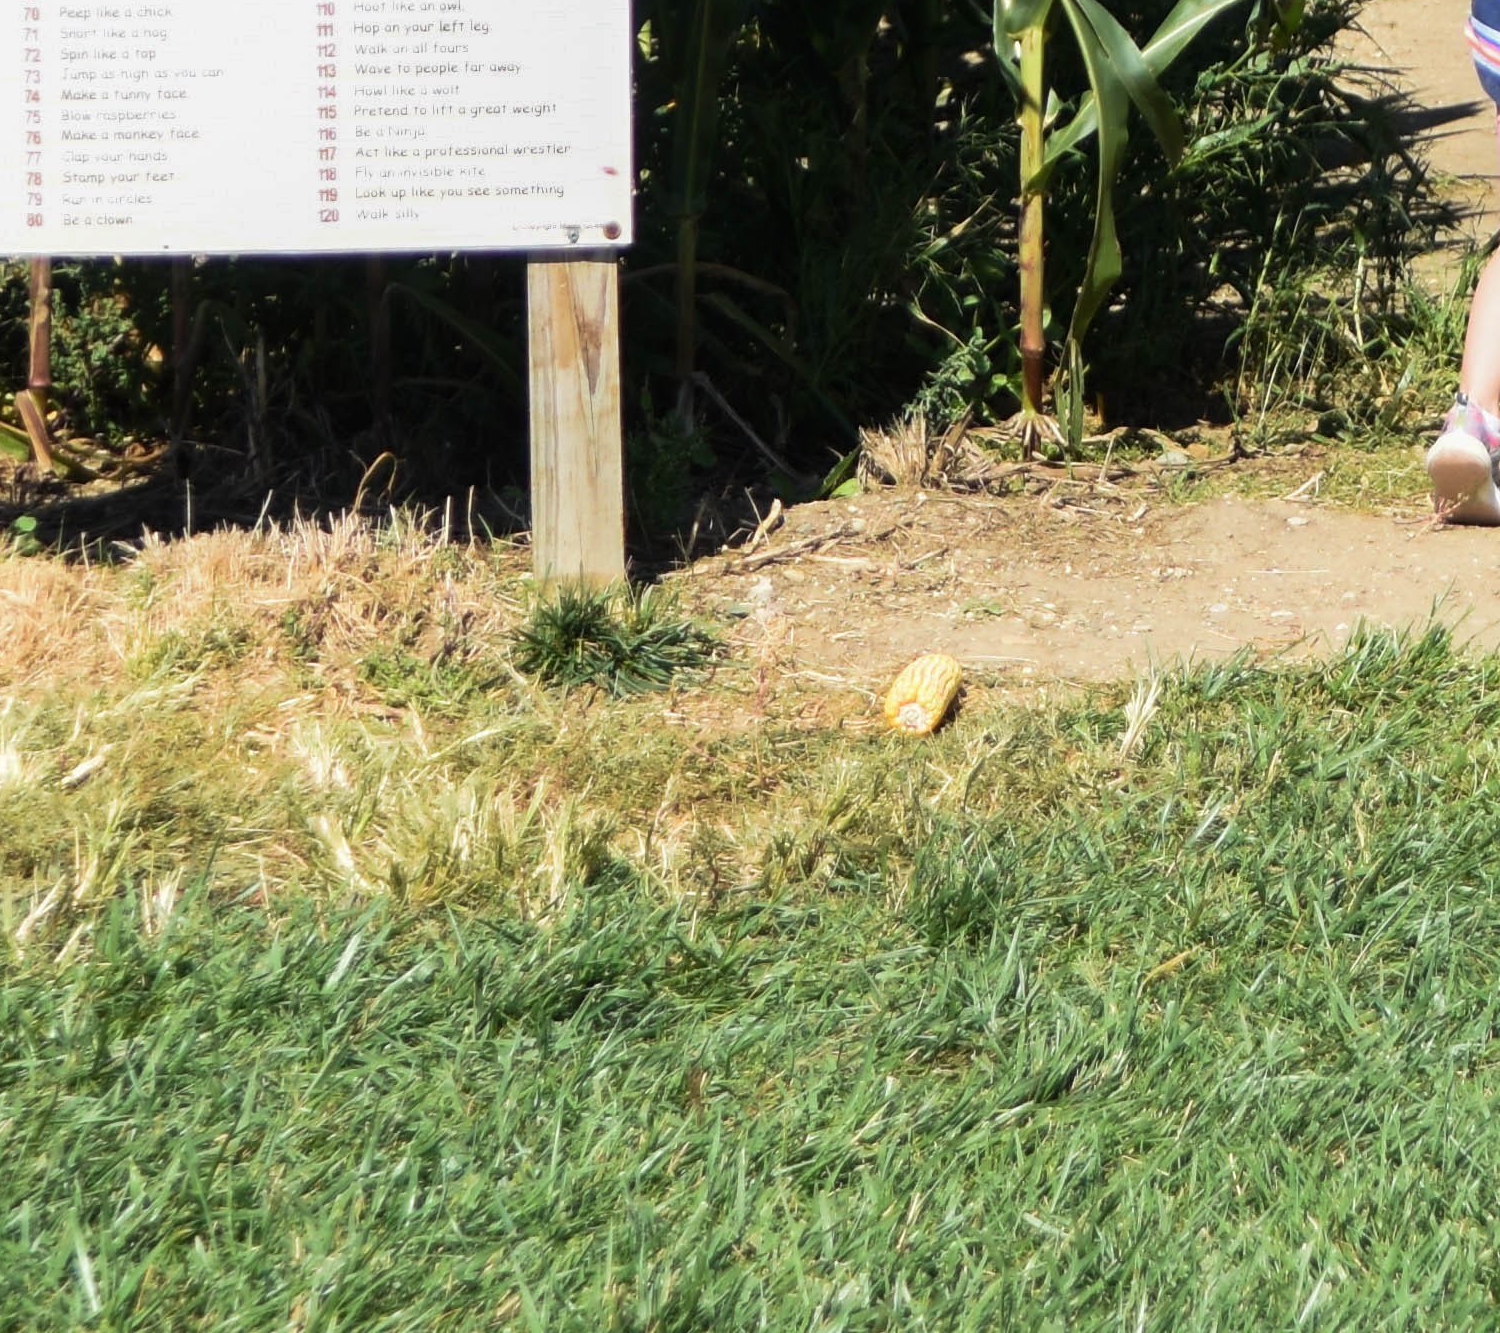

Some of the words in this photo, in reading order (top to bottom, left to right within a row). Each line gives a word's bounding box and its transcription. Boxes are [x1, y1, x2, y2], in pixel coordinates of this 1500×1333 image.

[316, 23, 333, 37] 111
[354, 22, 380, 35] Hop
[384, 23, 400, 34] on
[404, 23, 433, 35] your
[440, 21, 465, 32] left
[318, 64, 336, 78] 113
[355, 64, 391, 74] Wave
[398, 63, 410, 74] to
[416, 63, 458, 76] people
[465, 62, 484, 73] far
[490, 63, 521, 76] away
[318, 105, 337, 119] 115
[354, 104, 409, 117] Pretend
[414, 105, 427, 116] to
[433, 104, 452, 115] lift
[459, 106, 466, 115] a
[471, 104, 508, 118] great
[512, 103, 556, 116] weight
[318, 147, 337, 161] 117
[356, 147, 379, 157] Act
[386, 146, 408, 157] like
[413, 147, 420, 156] a
[425, 144, 508, 159] professional
[513, 143, 571, 155] wrestler
[319, 188, 338, 203] 119
[357, 187, 386, 198] Look
[392, 188, 406, 201] up
[412, 186, 435, 198] like
[440, 187, 463, 200] you
[468, 187, 490, 197] see
[496, 184, 564, 199] something
